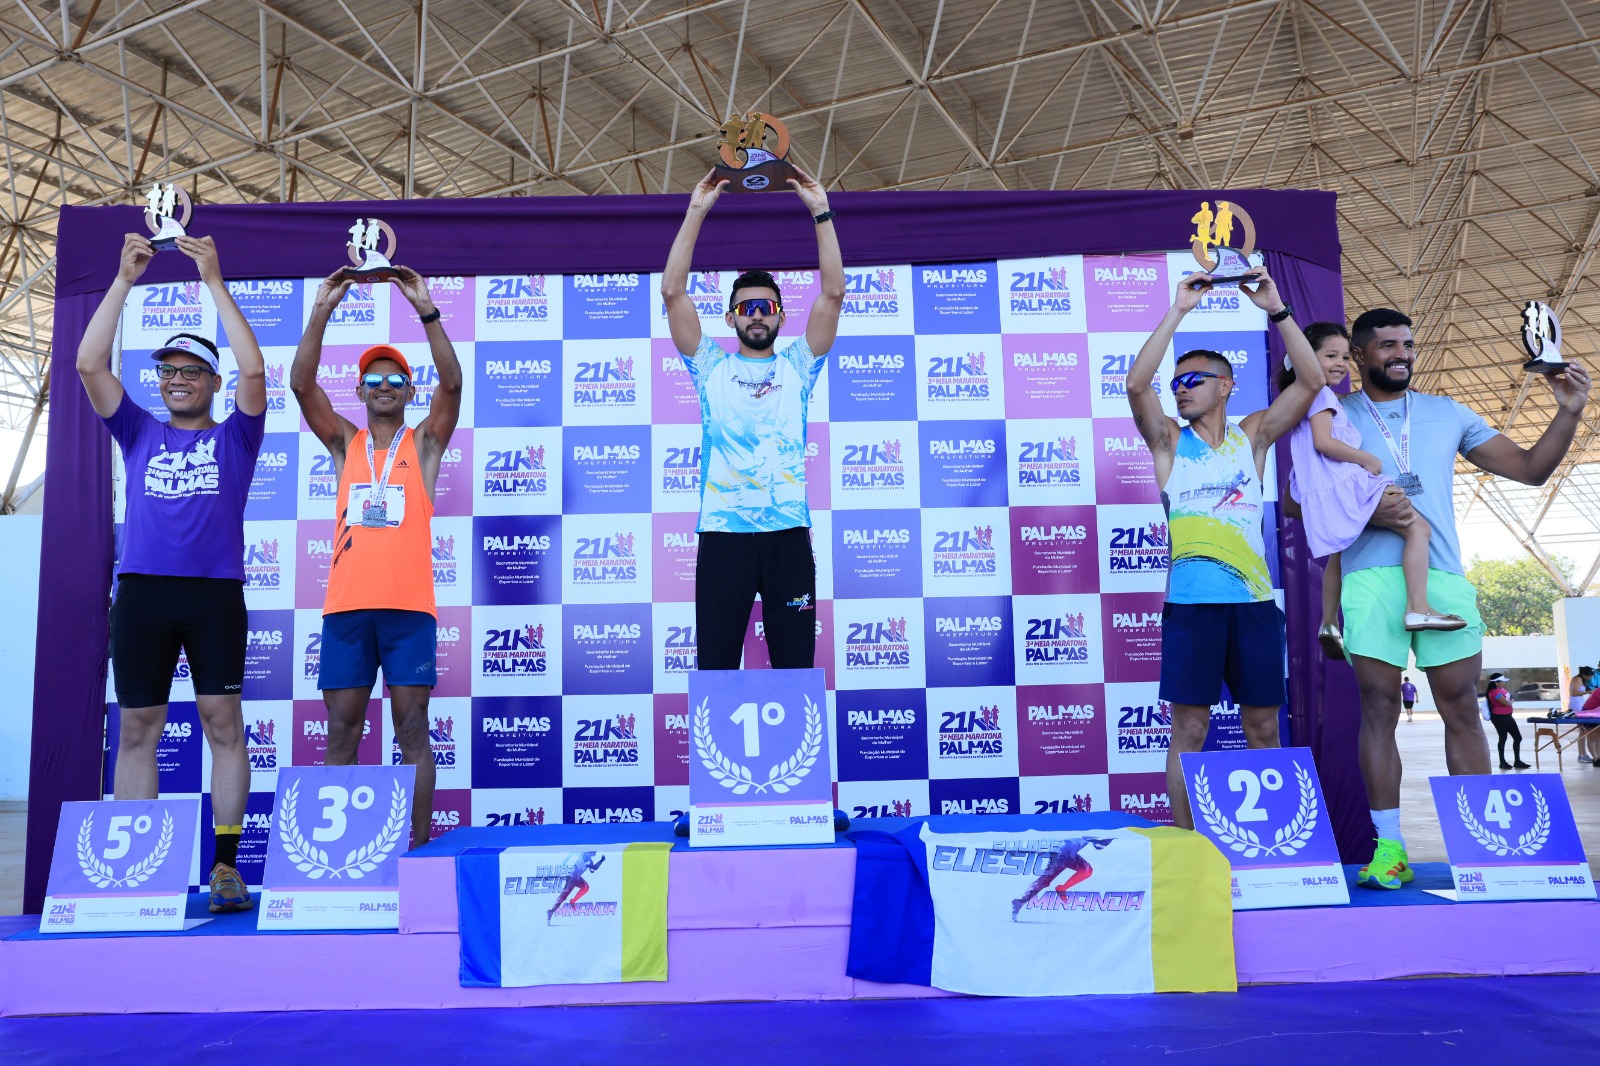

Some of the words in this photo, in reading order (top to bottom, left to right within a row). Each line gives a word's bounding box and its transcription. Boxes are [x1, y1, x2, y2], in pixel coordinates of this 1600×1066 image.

[574, 274, 639, 288] PALMAS
[923, 270, 987, 284] PALMAS
[1094, 267, 1157, 281] PALMAS
[229, 281, 292, 295] PALMAS
[1010, 272, 1068, 291] 21K
[487, 279, 546, 299] 21K
[142, 288, 200, 307] 21K
[1011, 299, 1071, 311] PALMAS
[487, 306, 547, 319] PALMAS
[142, 315, 201, 327] PALMAS
[839, 355, 904, 369] PALMAS
[1014, 352, 1078, 366] PALMAS
[486, 360, 551, 374] PALMAS
[574, 361, 635, 382] 21K
[927, 357, 987, 377] 21K
[574, 390, 636, 403] PALMAS
[928, 384, 989, 397] PALMAS
[574, 445, 640, 460] PALMAS
[930, 439, 995, 454] PALMAS
[1018, 441, 1078, 462] 21K
[485, 450, 546, 471] 21K
[842, 444, 902, 465] 21K
[842, 473, 904, 486] PALMAS
[1019, 470, 1080, 483] PALMAS
[145, 474, 219, 494] PALMAS
[484, 479, 547, 492] PALMAS
[843, 529, 910, 544] PALMAS
[1021, 525, 1086, 540] PALMAS
[1109, 527, 1169, 548] 21K
[484, 536, 550, 550] PALMAS
[574, 537, 635, 559] 21K
[933, 530, 994, 552] 21K
[573, 566, 636, 580] PALMAS
[934, 560, 996, 573] PALMAS
[936, 616, 1001, 632] PALMAS
[1025, 618, 1086, 640] 21K
[573, 624, 640, 639] PALMAS
[846, 622, 908, 644] 21K
[483, 629, 545, 650] 21K
[1051, 639, 1087, 647] MARATONA
[846, 652, 910, 665] PALMAS
[1026, 647, 1088, 661] PALMAS
[483, 659, 546, 672] PALMAS
[848, 709, 915, 725] PALMAS
[1028, 704, 1094, 720] PALMAS
[483, 717, 550, 732] PALMAS
[939, 710, 1000, 733] 21K
[574, 719, 637, 741] 21K
[965, 732, 1002, 740] MARATONA
[939, 740, 1003, 754] PALMAS
[574, 749, 638, 763] PALMAS
[942, 798, 1008, 814] PALMAS
[575, 808, 642, 823] PALMAS
[790, 816, 828, 824] PALMAS
[1302, 876, 1338, 886] PALMAS
[1548, 876, 1585, 884] PALMAS
[359, 902, 397, 911] PALMAS
[1026, 890, 1146, 912] MIRANDA
[140, 908, 177, 917] PALMAS
[555, 902, 618, 917] MIRANDA
